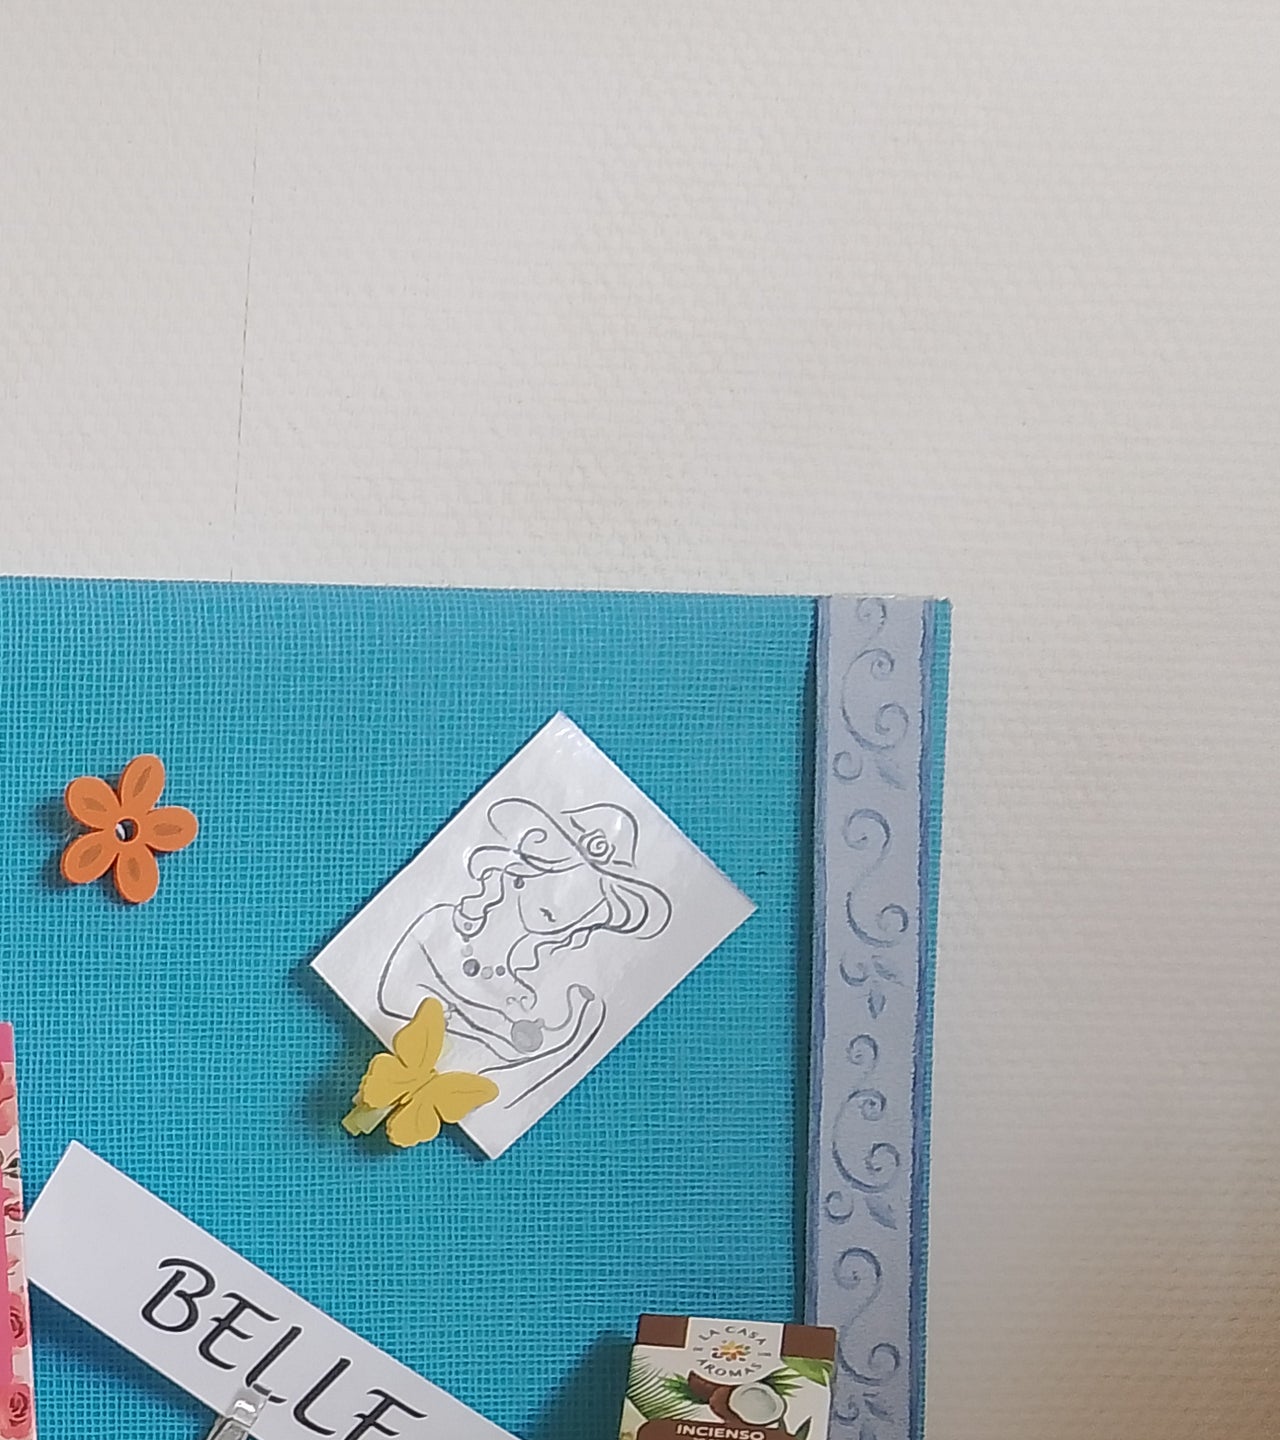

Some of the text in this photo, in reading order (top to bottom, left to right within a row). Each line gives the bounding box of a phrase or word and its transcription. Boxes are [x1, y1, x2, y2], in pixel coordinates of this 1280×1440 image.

[698, 1326, 767, 1346] LA CASA
[696, 1359, 763, 1377] AROMAS
